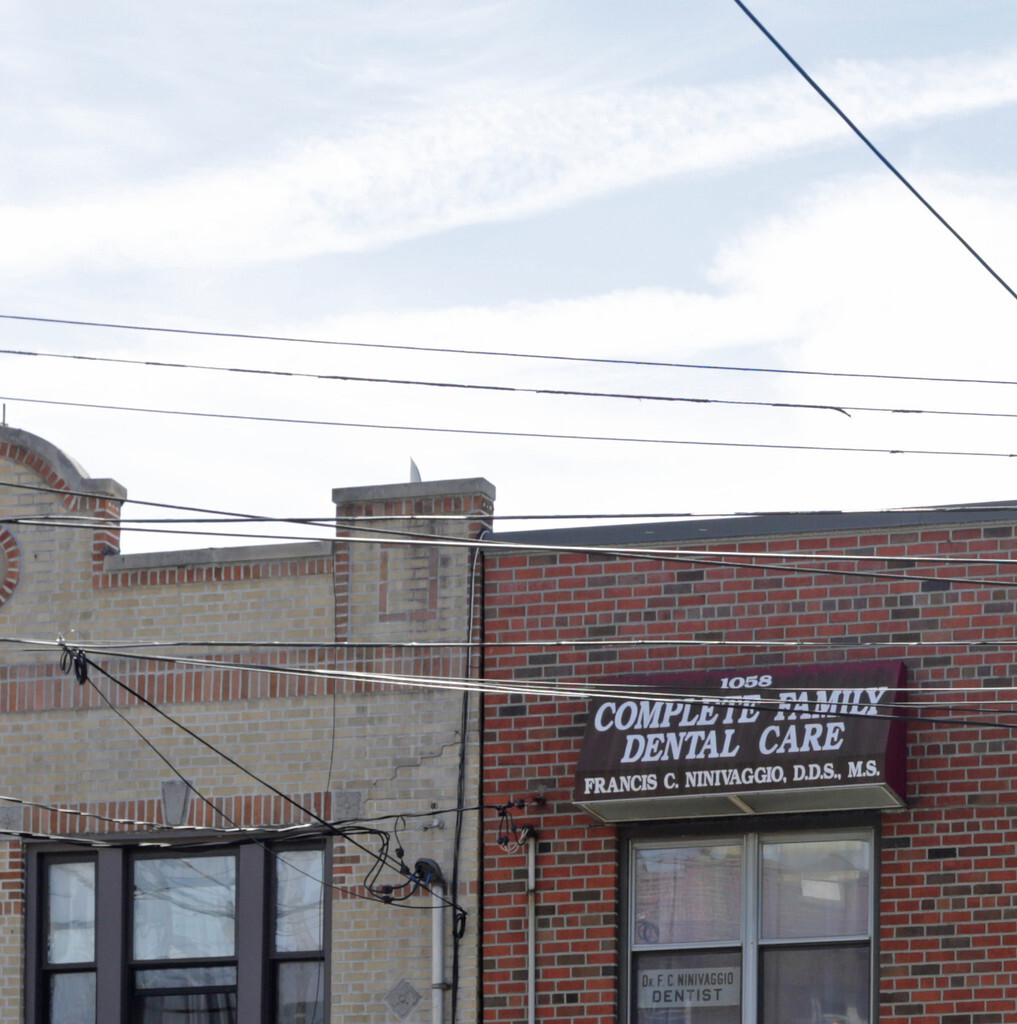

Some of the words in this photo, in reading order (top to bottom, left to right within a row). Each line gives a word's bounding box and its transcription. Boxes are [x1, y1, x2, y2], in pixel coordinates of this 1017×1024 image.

[720, 674, 773, 689] 1058
[593, 694, 762, 732] COMPLETE
[774, 686, 888, 722] FAMILY
[620, 728, 740, 764] DENTAL
[758, 722, 846, 755] CARE
[583, 773, 657, 795] FRANCIS
[663, 772, 680, 789] C.
[685, 766, 787, 789] NINIVAGGIO,
[793, 763, 842, 782] D.D.S.,
[847, 760, 881, 778] M.S.
[677, 972, 734, 986] NINIVAGGIO
[652, 988, 722, 1003] DENTIST
